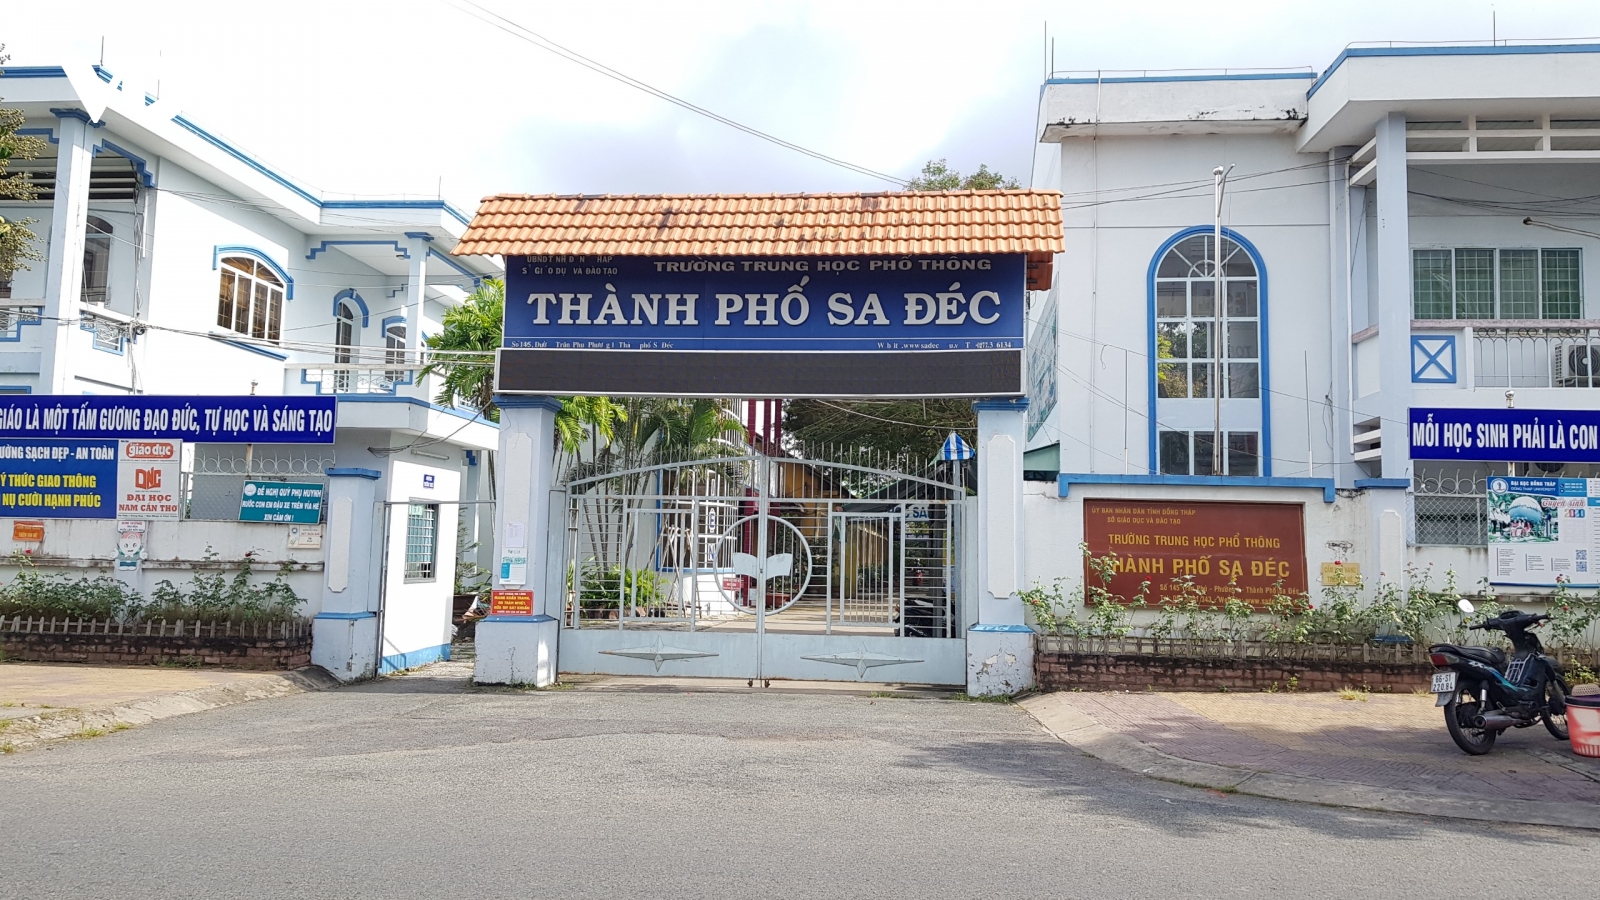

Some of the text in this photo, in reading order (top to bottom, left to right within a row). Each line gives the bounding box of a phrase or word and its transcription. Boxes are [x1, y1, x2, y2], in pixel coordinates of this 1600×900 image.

[548, 256, 566, 264] TNH
[654, 257, 734, 272] TRƯỜNG
[740, 260, 808, 272] TRUNG
[817, 260, 860, 275] HỌC
[918, 256, 992, 270] THÔNG
[573, 266, 582, 274] VÀ
[586, 266, 600, 274] ĐÀO
[603, 268, 618, 277] TẠO
[526, 275, 1000, 326] THÀNH PHỐ SA ĐÉC
[26, 404, 39, 430] LÀ
[43, 403, 69, 435] MỘT
[72, 401, 97, 430] TẤM
[100, 406, 141, 430] GƯƠNG
[144, 408, 168, 436] ĐẠO
[172, 402, 200, 435] ĐỨC,
[205, 406, 222, 436] TỰ
[223, 409, 249, 436] HỌC
[253, 404, 269, 432] VÀ
[272, 404, 305, 432] SÁNG
[309, 410, 333, 436] TẠO
[1412, 413, 1598, 452] MỖI HỌC SINH PHẢI LÀ CON
[25, 446, 50, 462] SẠCH
[52, 447, 70, 462] ĐẸP
[76, 447, 89, 459] AN
[90, 445, 114, 460] TOÀN
[128, 443, 170, 457] giáo dục
[8, 472, 35, 487] THỨC
[37, 474, 61, 487] GIAO
[62, 473, 96, 488] THÔNG
[2, 491, 101, 509] NỤ CƯỜI HẠNH PHÚC
[127, 494, 171, 503] ĐẠI HỌC
[291, 488, 302, 499] PHỤ
[1108, 532, 1280, 548] TRƯỜNG TRUNG HỌC PHỔ THÔNG
[1112, 554, 1290, 577] HÀNH PHỐ SA ĐÉC
